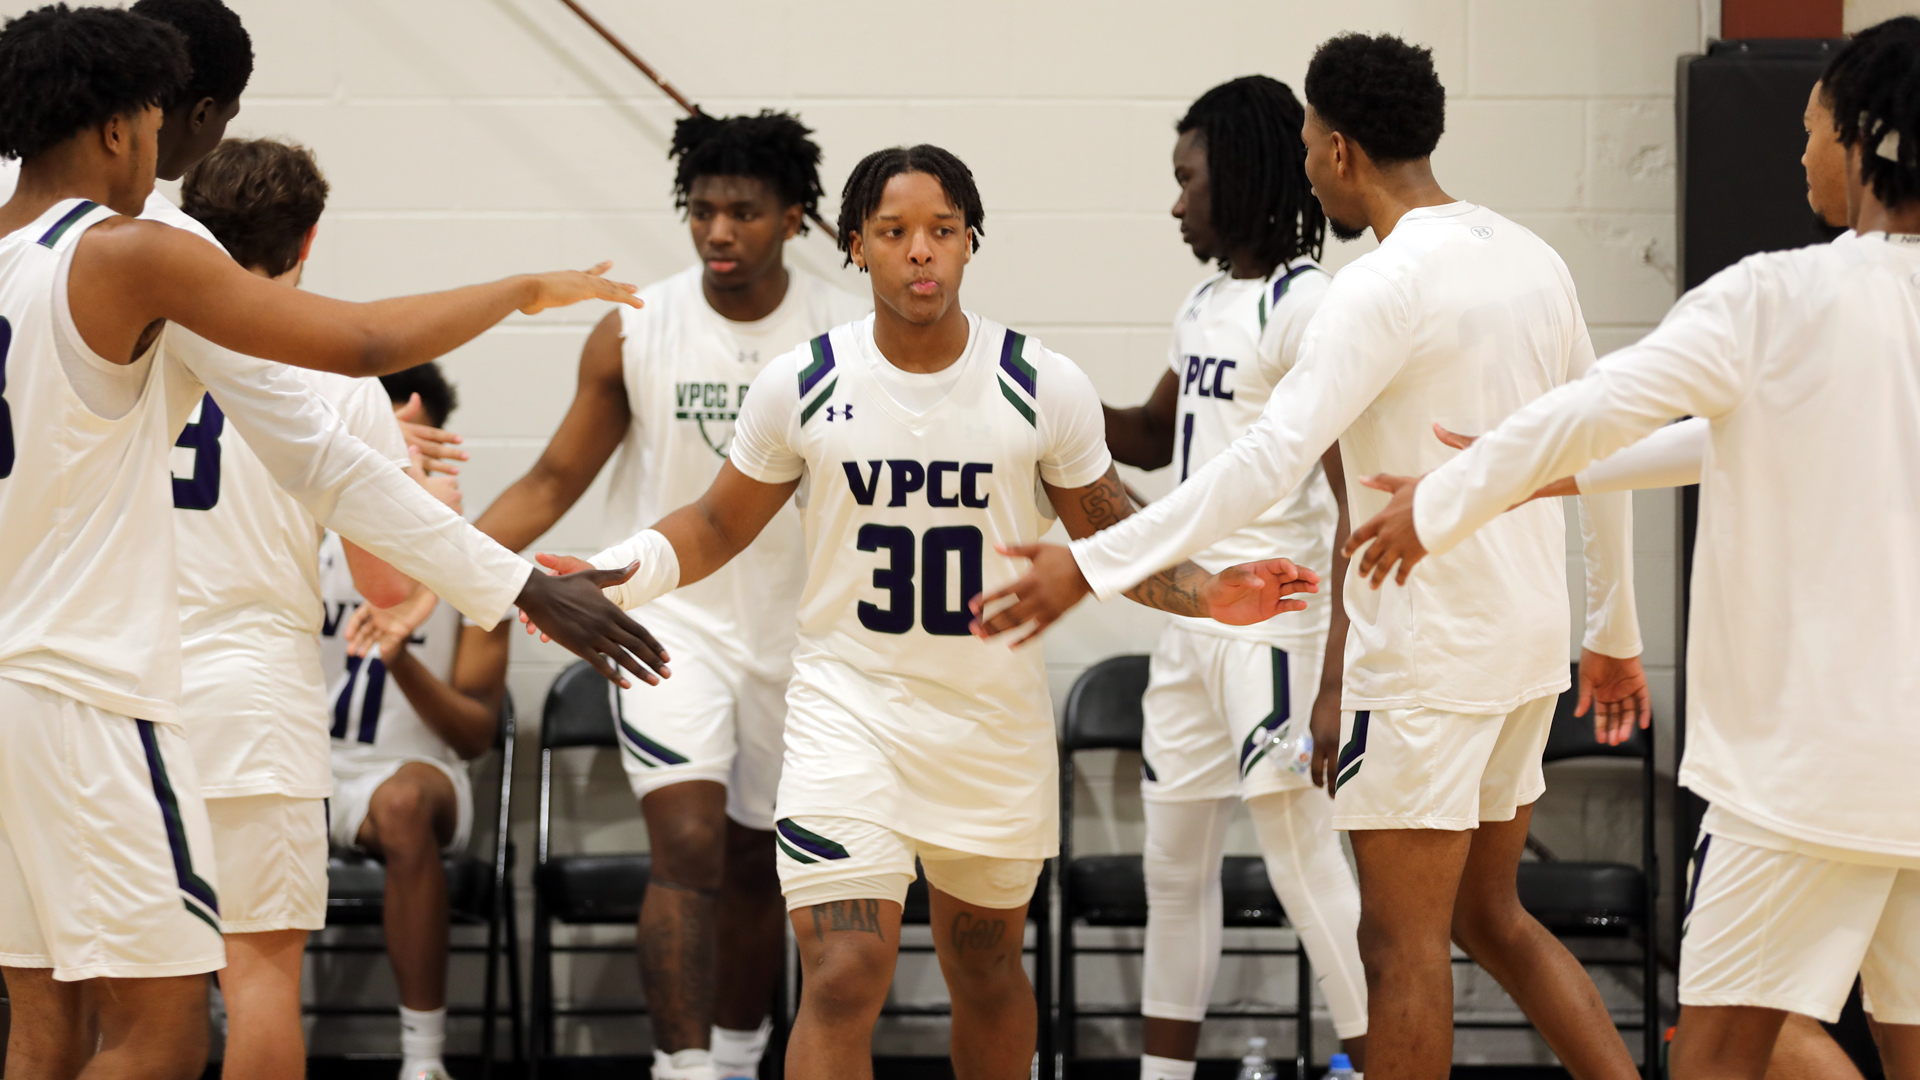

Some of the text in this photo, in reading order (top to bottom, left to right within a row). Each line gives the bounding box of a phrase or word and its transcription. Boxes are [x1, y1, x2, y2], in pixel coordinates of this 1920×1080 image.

[676, 383, 727, 408] VPCC
[1184, 355, 1236, 400] PCC
[842, 459, 993, 509] VPCC
[857, 522, 983, 636] 30
[811, 898, 885, 943] FEAR
